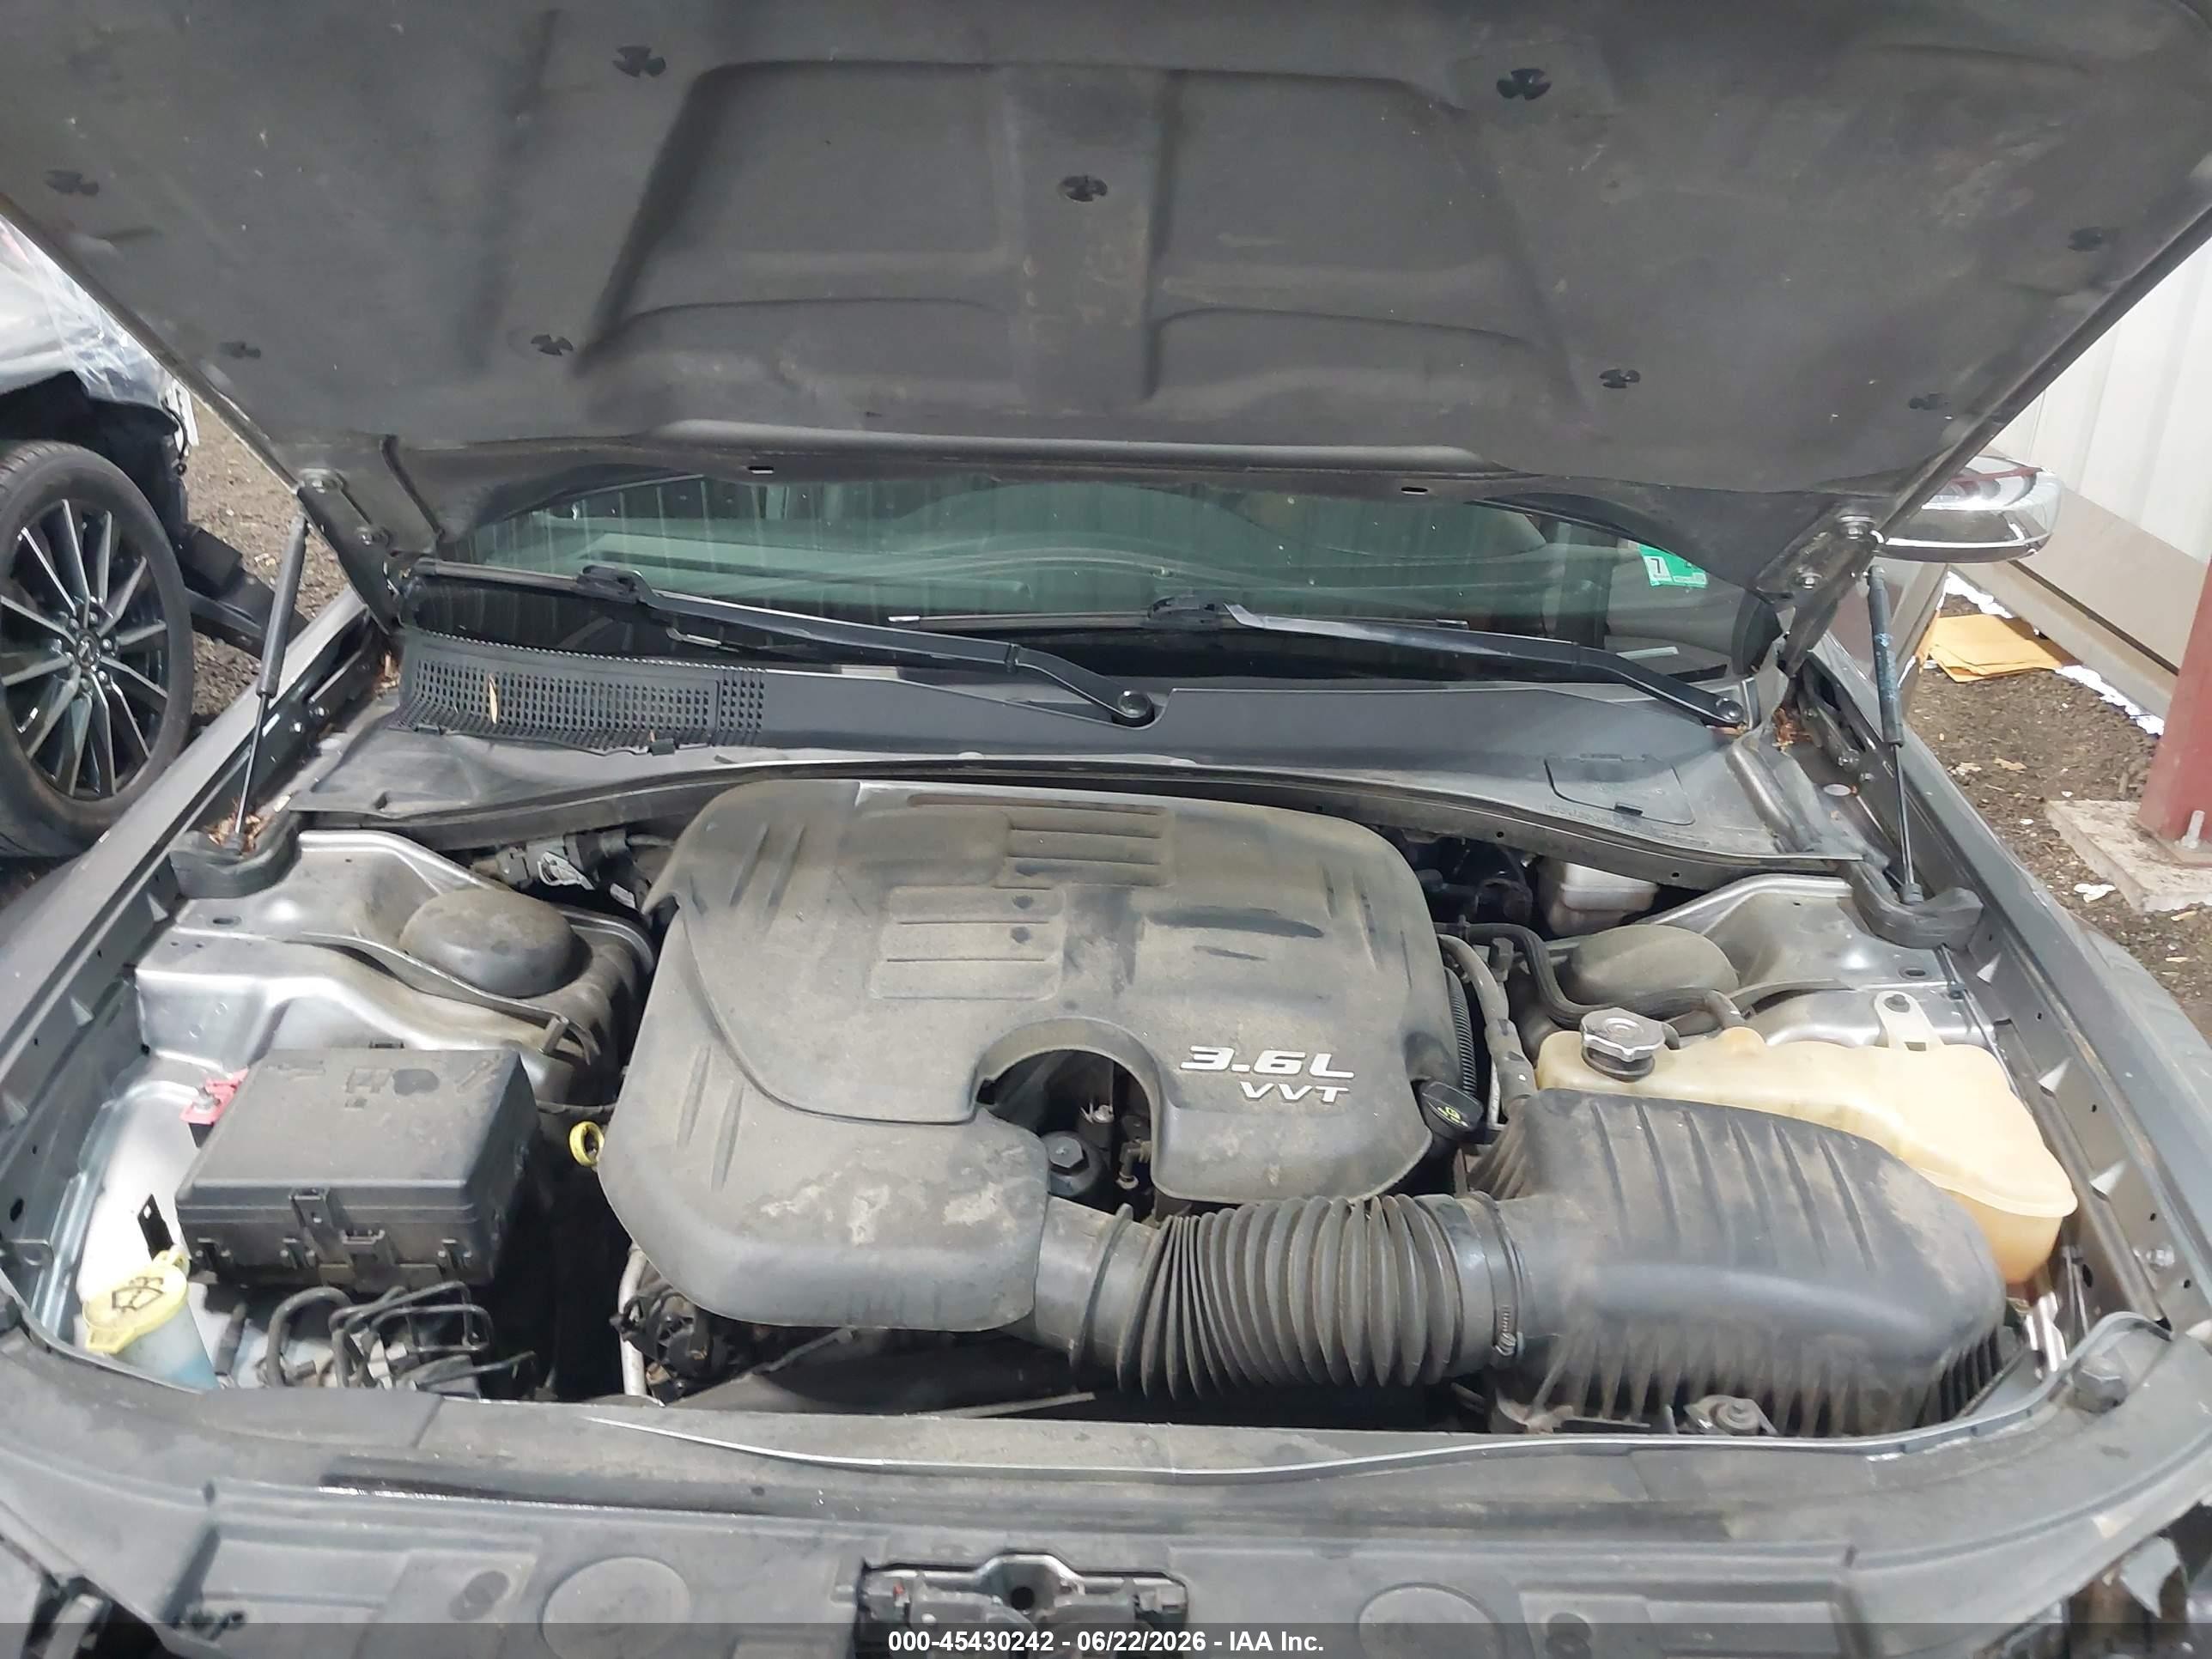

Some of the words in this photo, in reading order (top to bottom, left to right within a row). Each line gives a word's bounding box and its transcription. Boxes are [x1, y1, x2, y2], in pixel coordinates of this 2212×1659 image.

[1650, 557, 1661, 574] 7
[1180, 1045, 1356, 1079] 3.6L
[1240, 1080, 1350, 1103] VVT
